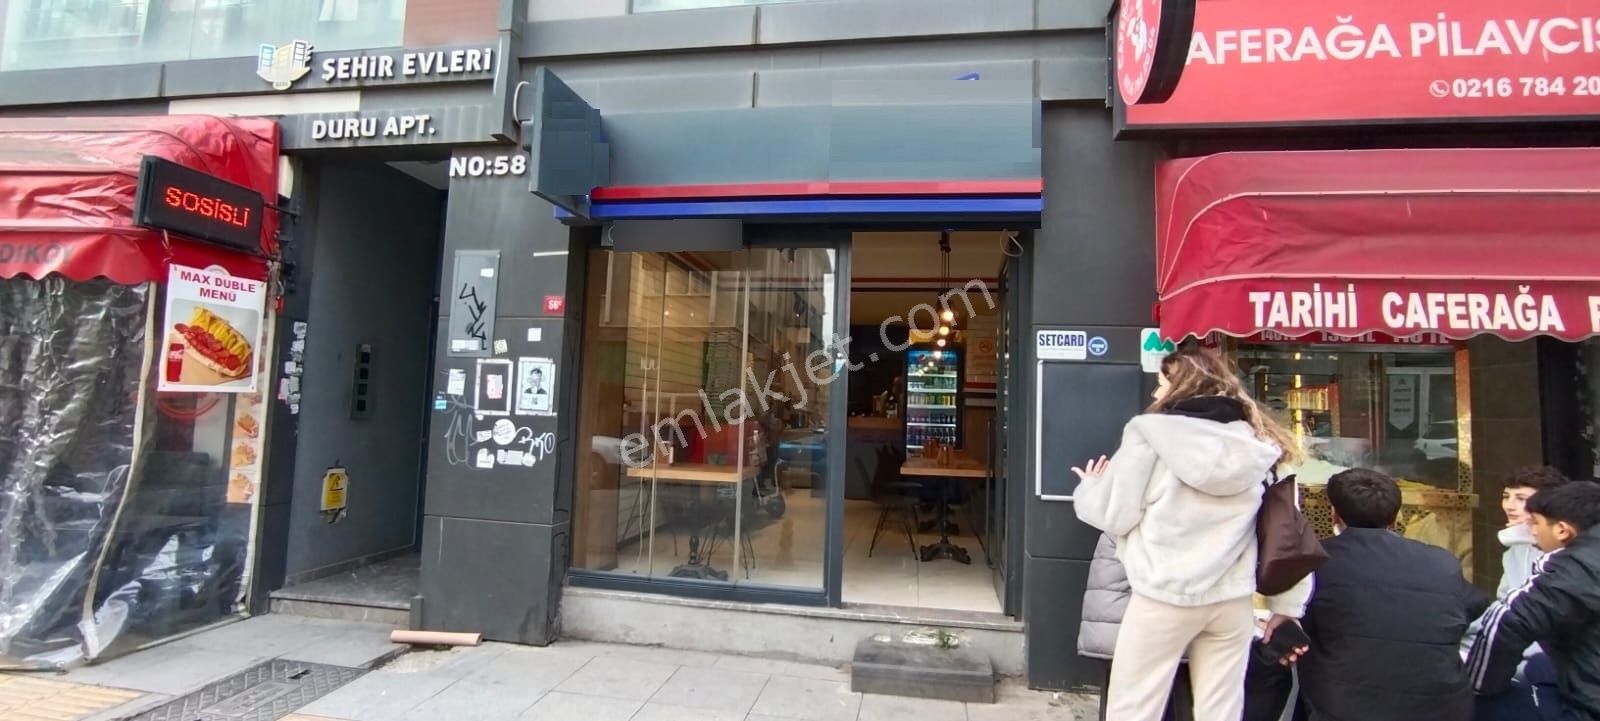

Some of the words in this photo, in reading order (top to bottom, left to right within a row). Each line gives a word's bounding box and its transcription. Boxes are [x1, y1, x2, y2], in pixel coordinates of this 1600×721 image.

[1410, 12, 1600, 57] PİLAVCI
[322, 55, 394, 81] ŞEHİR
[402, 48, 493, 76] EVLERİ
[1453, 77, 1512, 97] 0216
[1519, 76, 1566, 96] 784
[1573, 75, 1600, 95] 20
[312, 117, 377, 139] DURU
[383, 114, 435, 136] APT.
[449, 155, 526, 177] NO:58
[165, 187, 251, 228] SOSİSLİ
[180, 271, 210, 285] MAX
[215, 277, 256, 293] DUBLE
[200, 288, 237, 302] MENÜ
[1249, 283, 1357, 327] TARİHİ
[1381, 284, 1566, 331] CAFERAĞA
[1039, 334, 1085, 346] SETCARD
